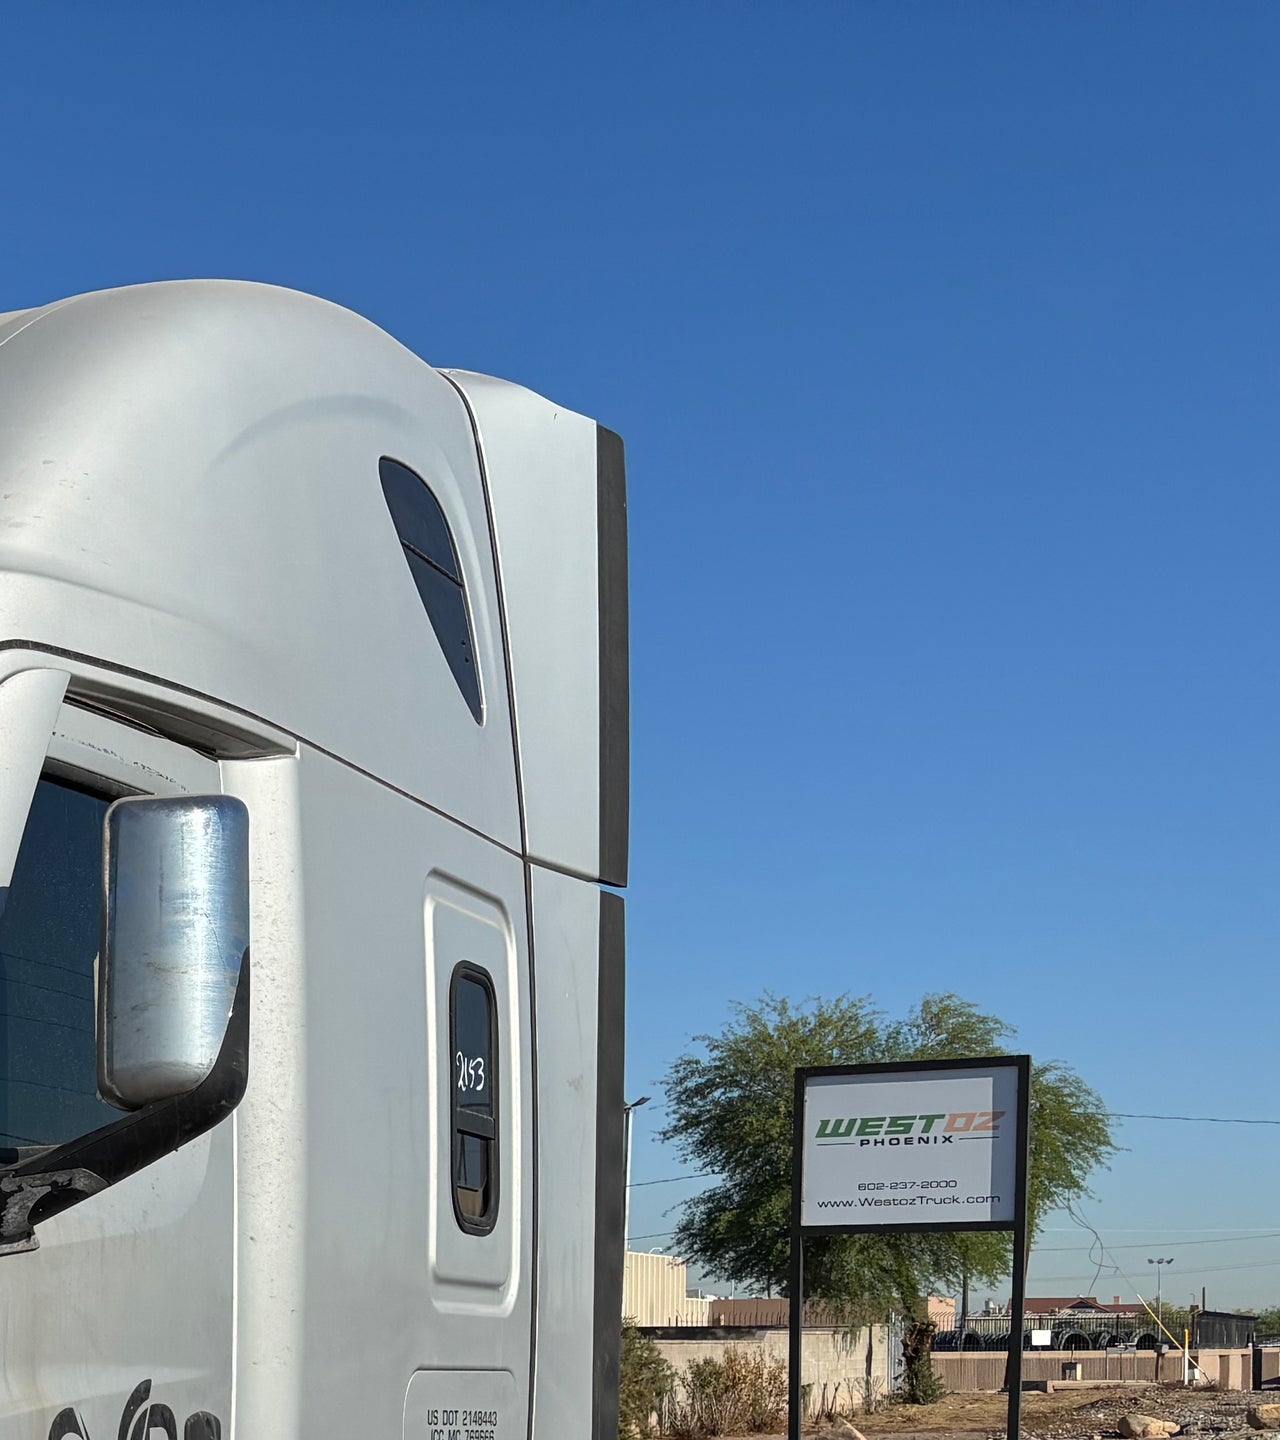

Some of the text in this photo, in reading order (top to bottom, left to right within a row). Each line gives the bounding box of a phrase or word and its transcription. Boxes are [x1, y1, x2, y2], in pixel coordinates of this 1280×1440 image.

[456, 1050, 485, 1091] 2153
[859, 1135, 954, 1147] PHOENIX
[858, 1180, 957, 1191] 602-237-2000
[817, 1194, 1000, 1208] www.WestozTruck.com
[427, 1409, 498, 1427] US DOT 2148443
